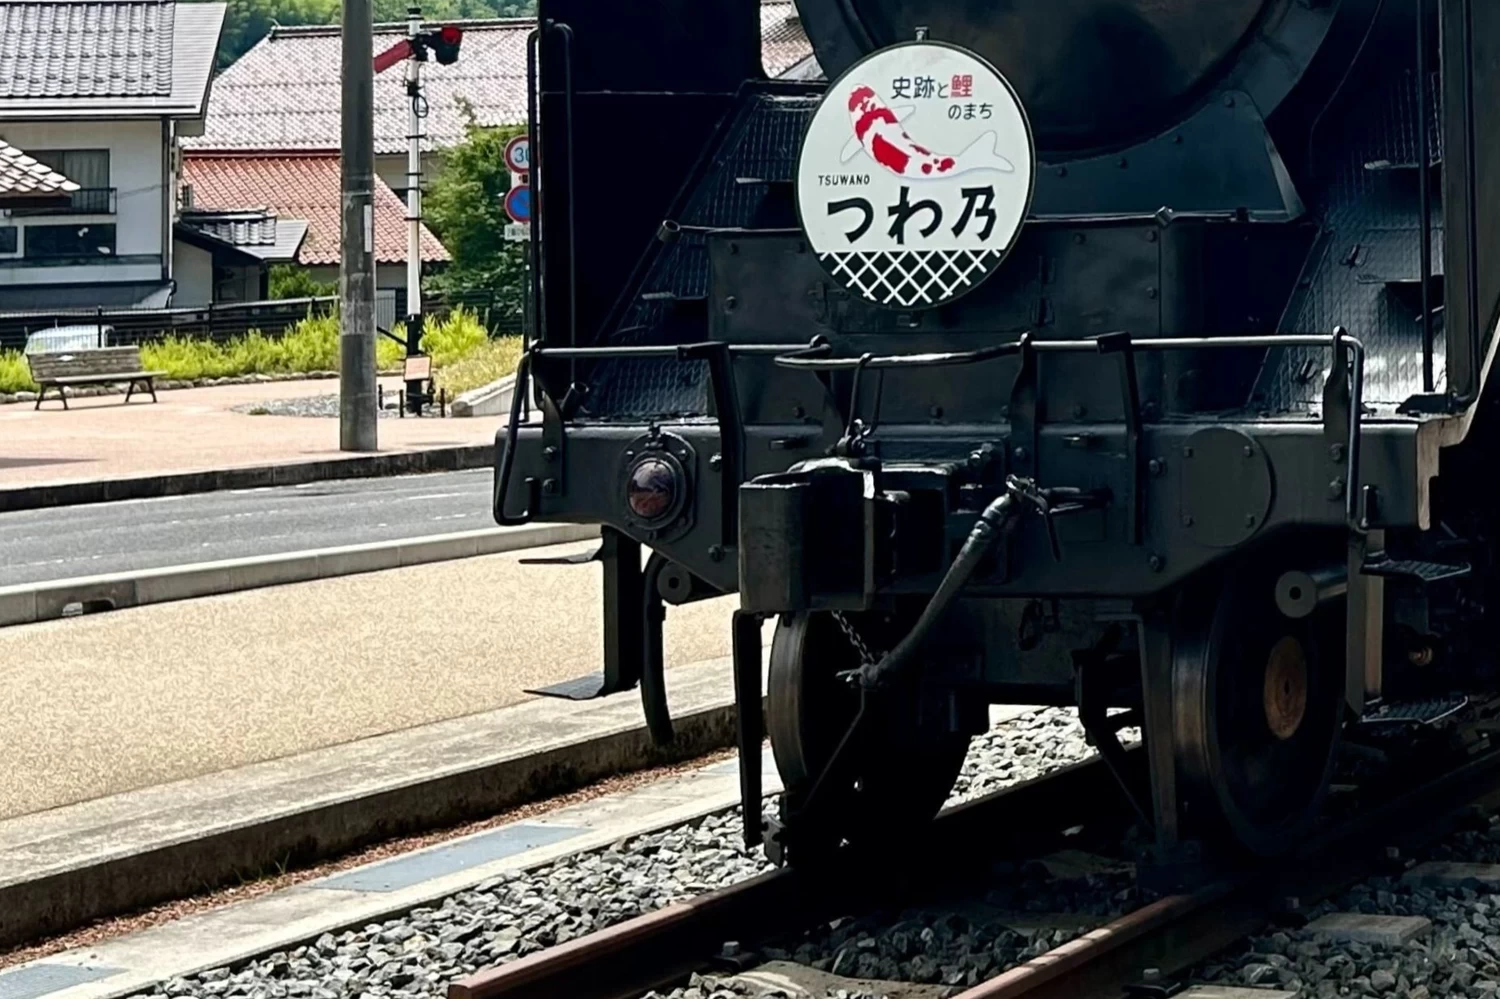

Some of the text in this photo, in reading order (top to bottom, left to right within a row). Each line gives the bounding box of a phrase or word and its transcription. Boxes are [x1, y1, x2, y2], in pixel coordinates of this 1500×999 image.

[891, 74, 973, 99] 史跡と鯉
[948, 102, 994, 120] のまち
[818, 174, 870, 186] TSUWANO
[827, 186, 997, 245] つわ乃
